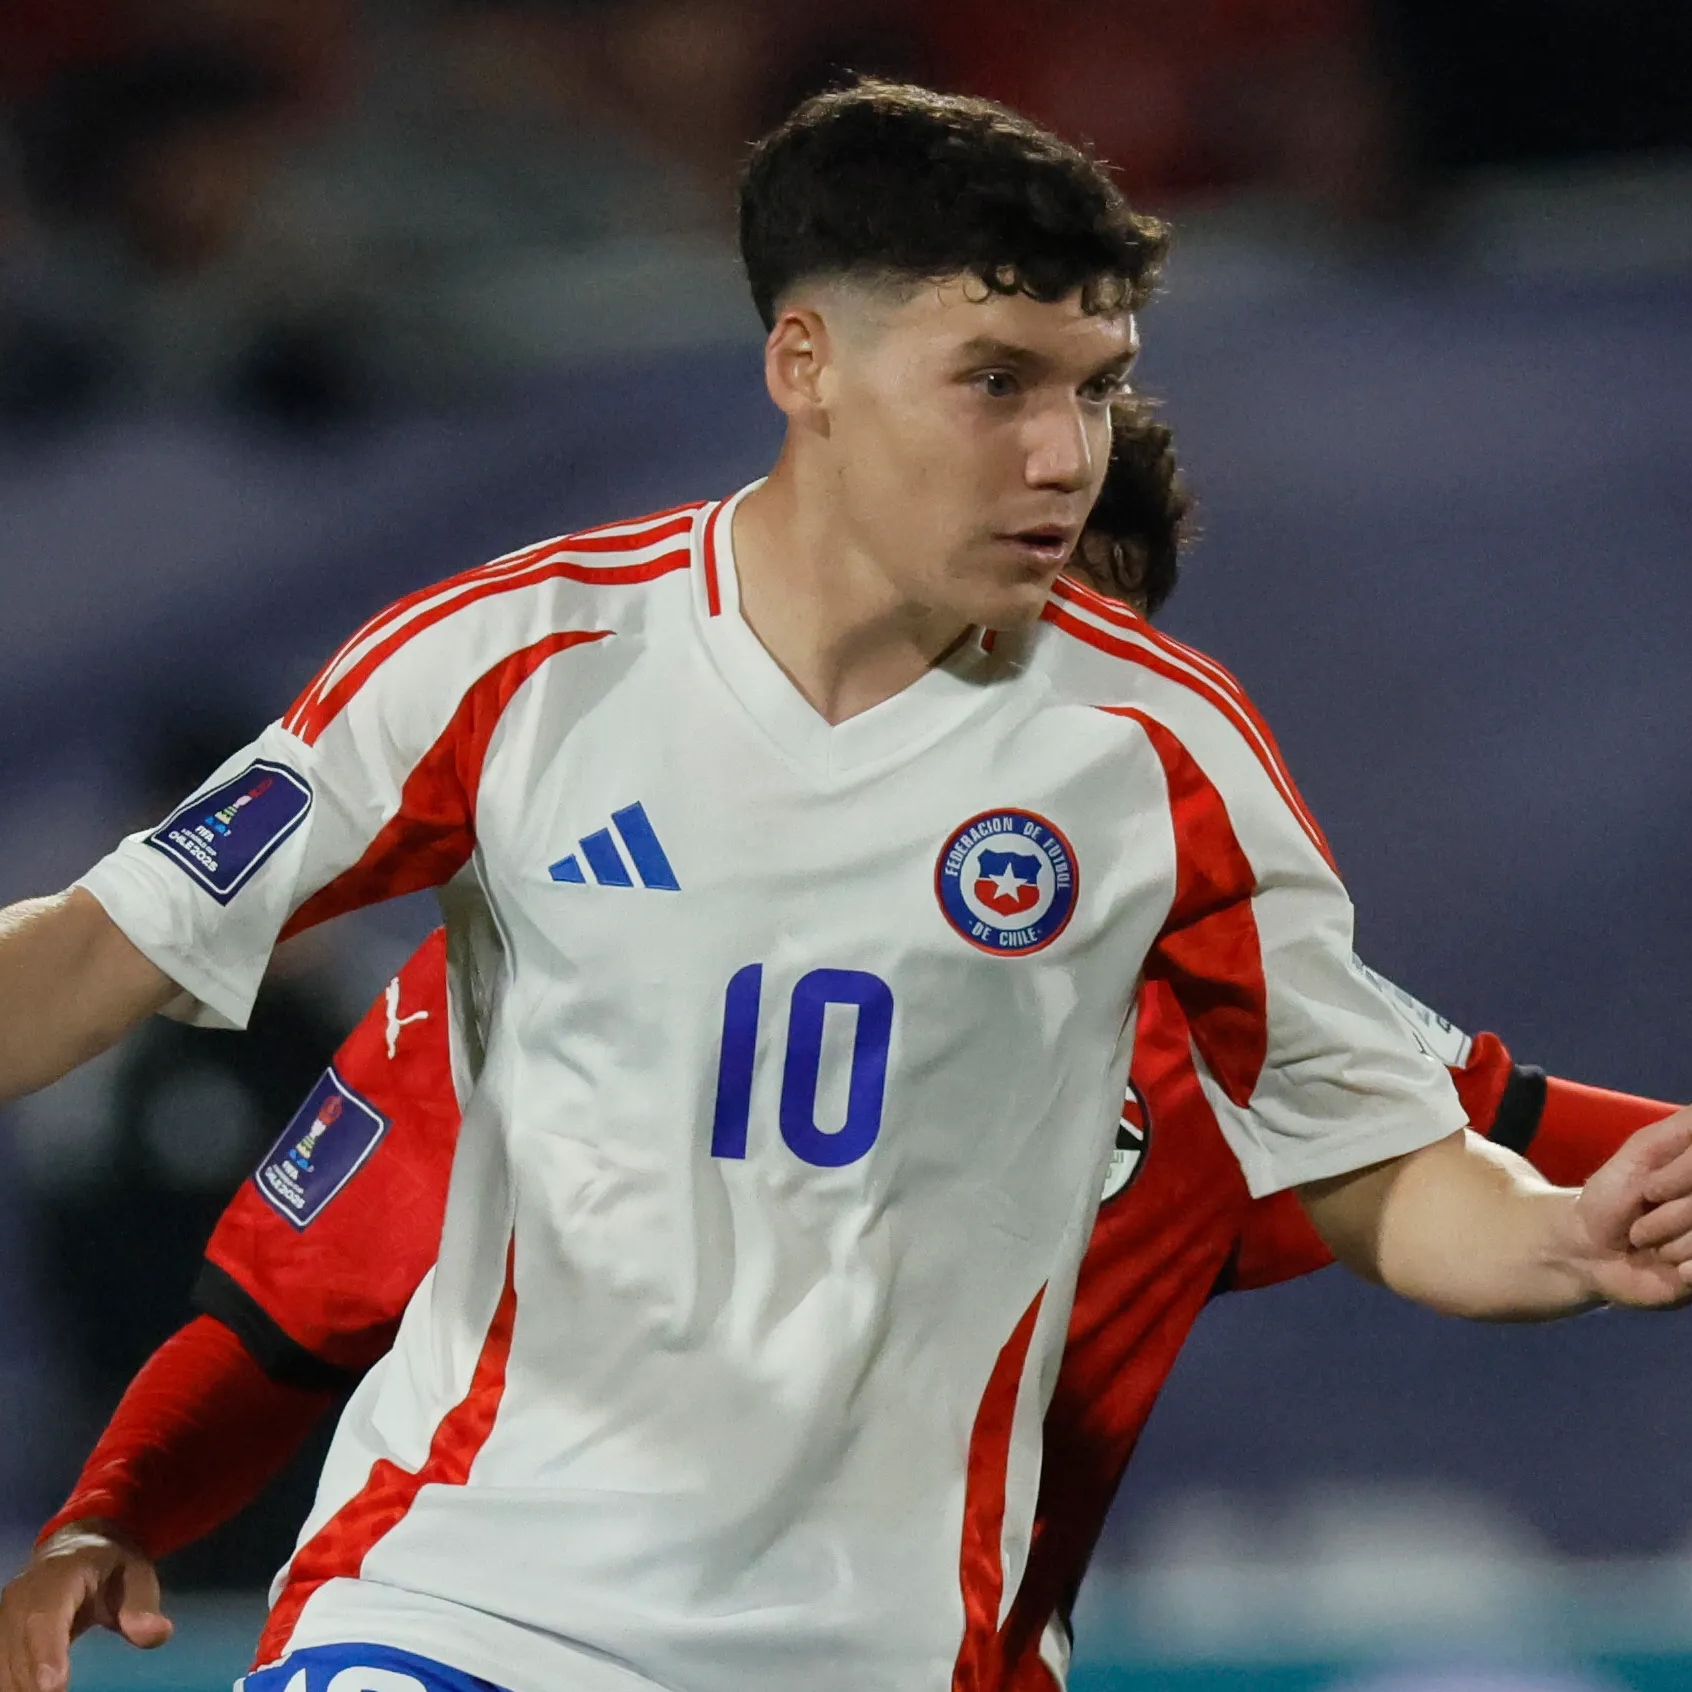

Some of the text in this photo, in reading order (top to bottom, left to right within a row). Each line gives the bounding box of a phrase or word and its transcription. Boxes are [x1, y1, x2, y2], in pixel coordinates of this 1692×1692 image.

[945, 817, 1013, 877] FEDERACION
[1023, 821, 1043, 840] DE
[971, 921, 1038, 947] DE CHILE
[710, 962, 895, 1168] 10
